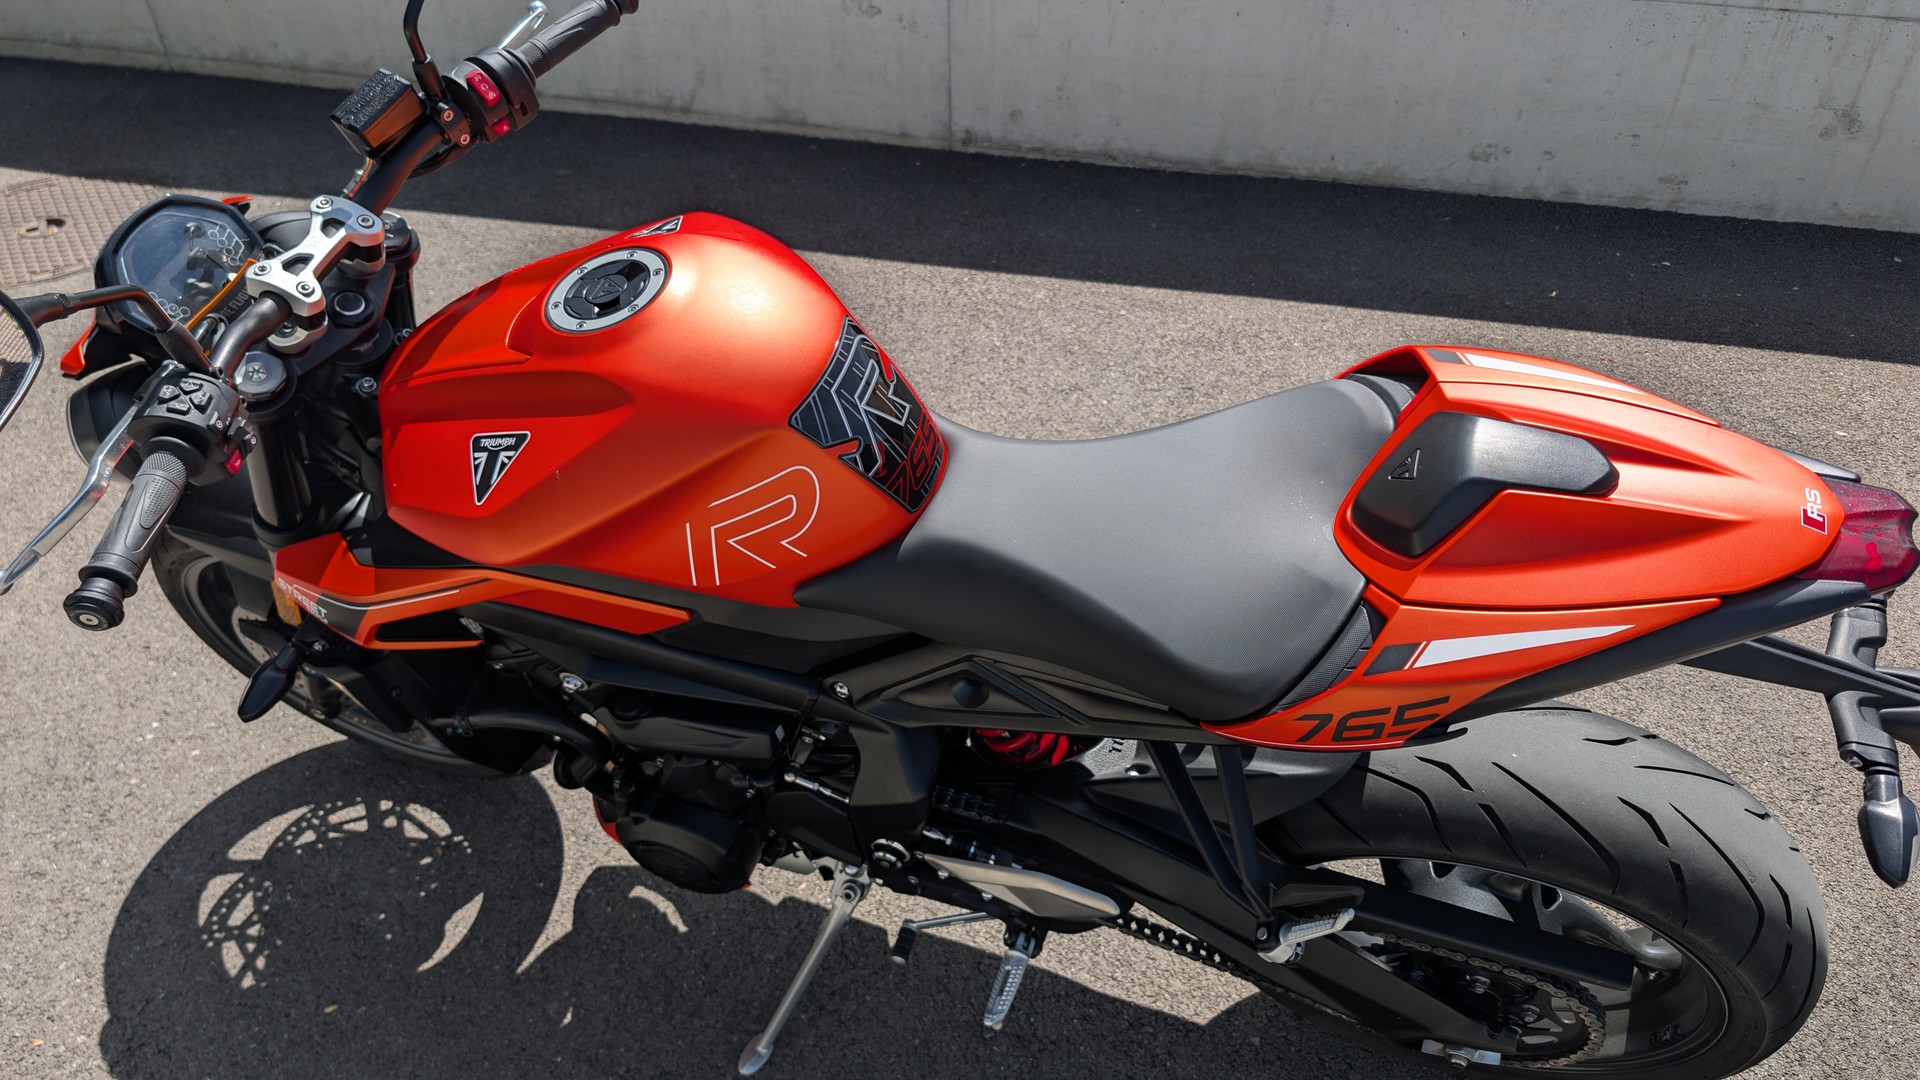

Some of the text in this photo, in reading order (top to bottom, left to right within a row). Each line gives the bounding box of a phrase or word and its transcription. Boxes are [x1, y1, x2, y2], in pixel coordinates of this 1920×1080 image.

[480, 437, 516, 449] TRIUMPH
[1804, 487, 1824, 523] RS
[278, 577, 328, 618] STREET
[1294, 695, 1451, 742] 765
